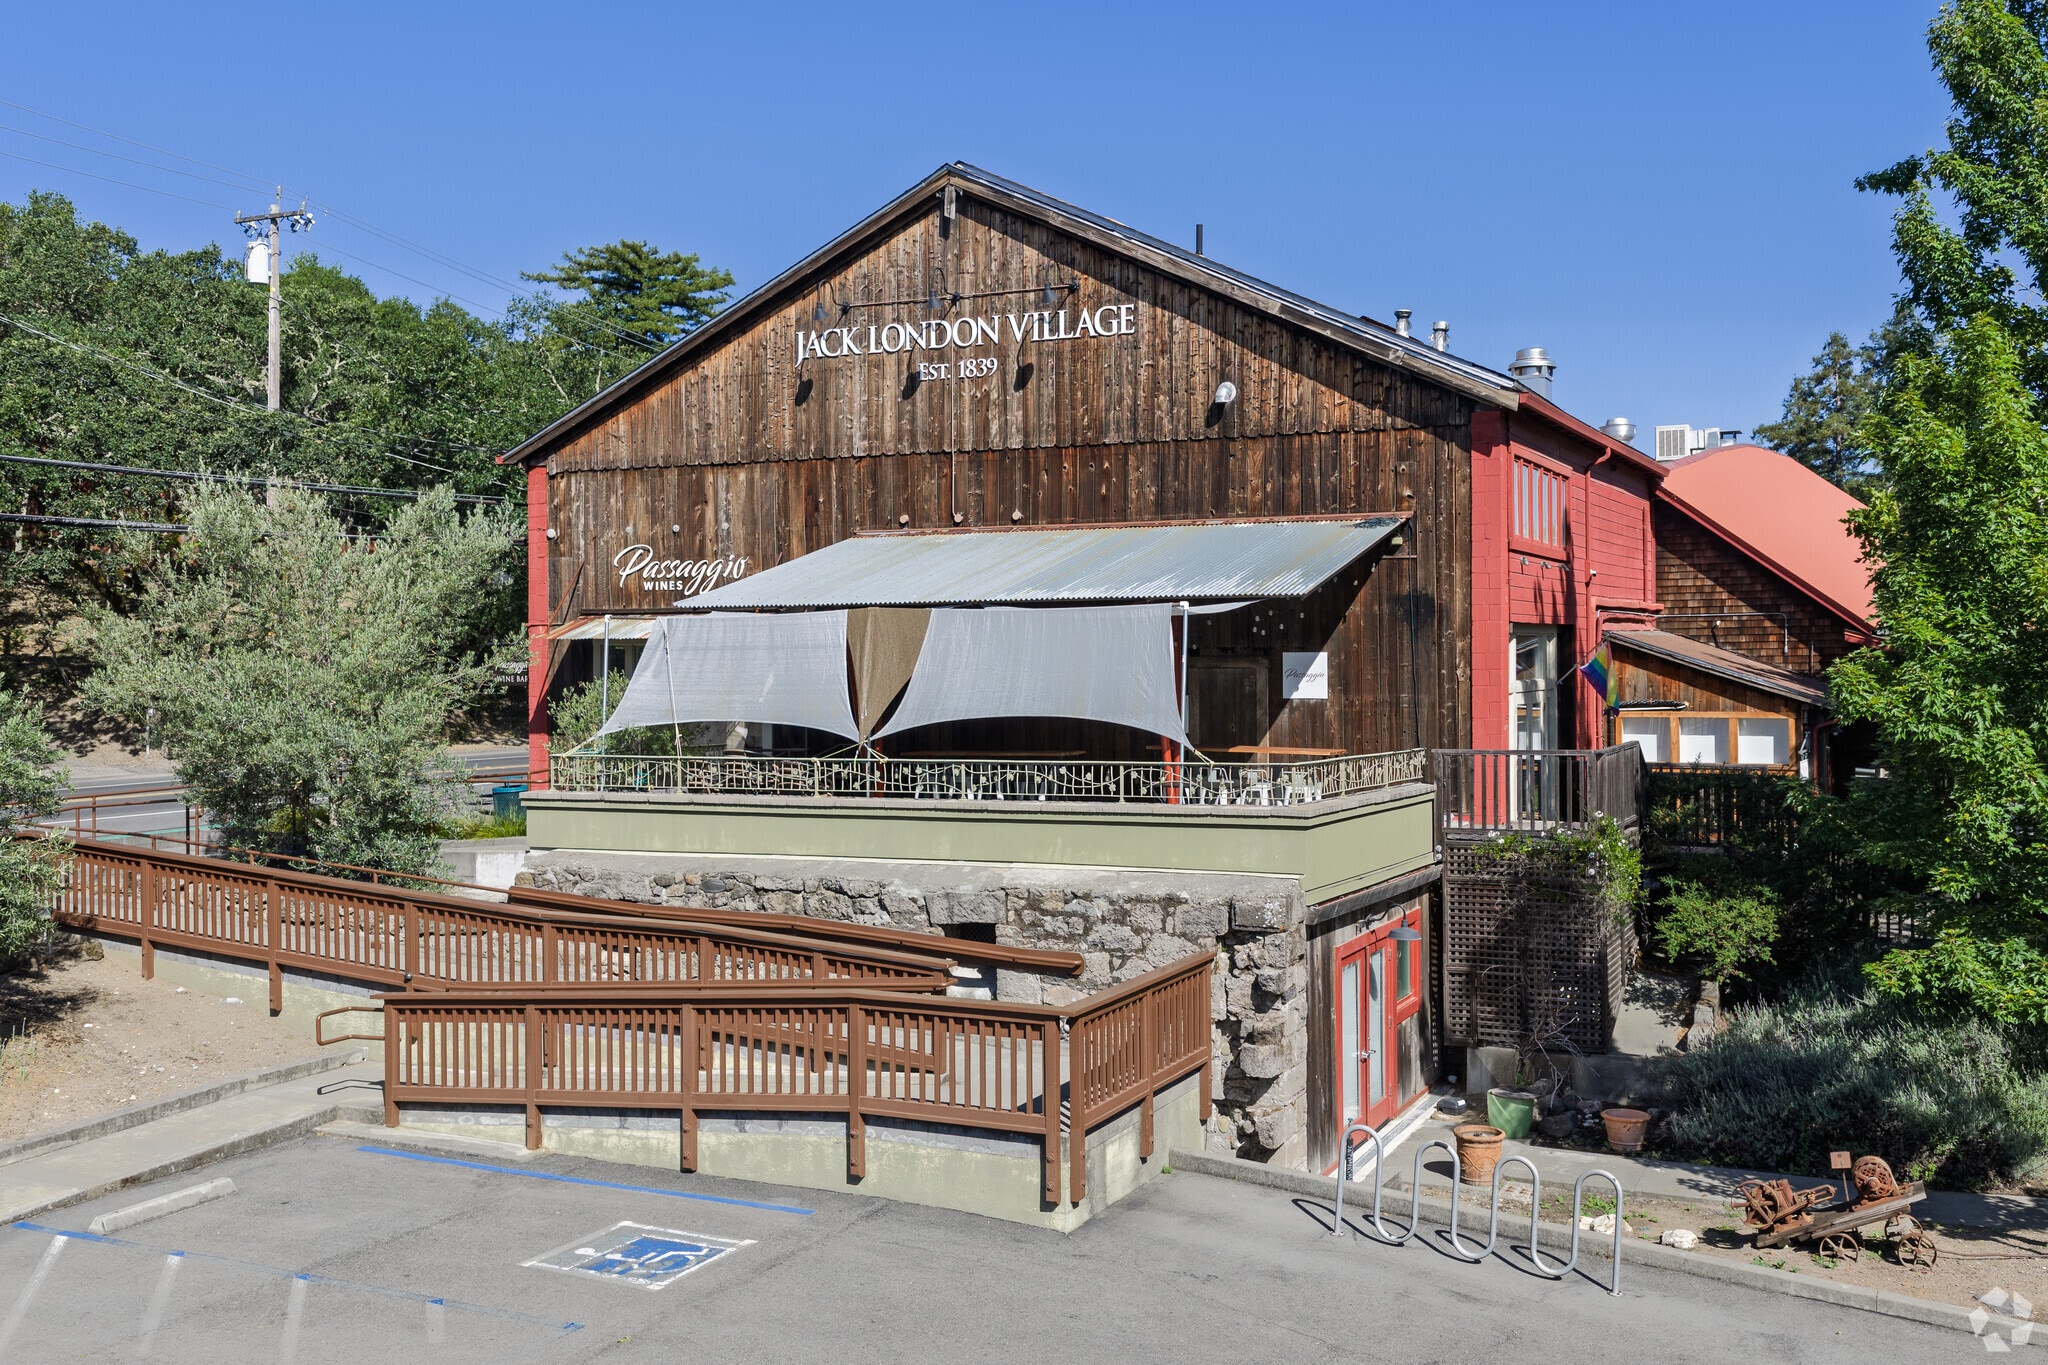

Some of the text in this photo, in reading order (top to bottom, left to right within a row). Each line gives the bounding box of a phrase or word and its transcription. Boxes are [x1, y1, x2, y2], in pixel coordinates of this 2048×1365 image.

[795, 303, 1137, 368] JACK LONDON VILLAGE
[918, 357, 998, 382] EST. 1839
[613, 543, 750, 596] Passaggio
[643, 580, 684, 591] WINES
[1284, 667, 1325, 683] Passaggio
